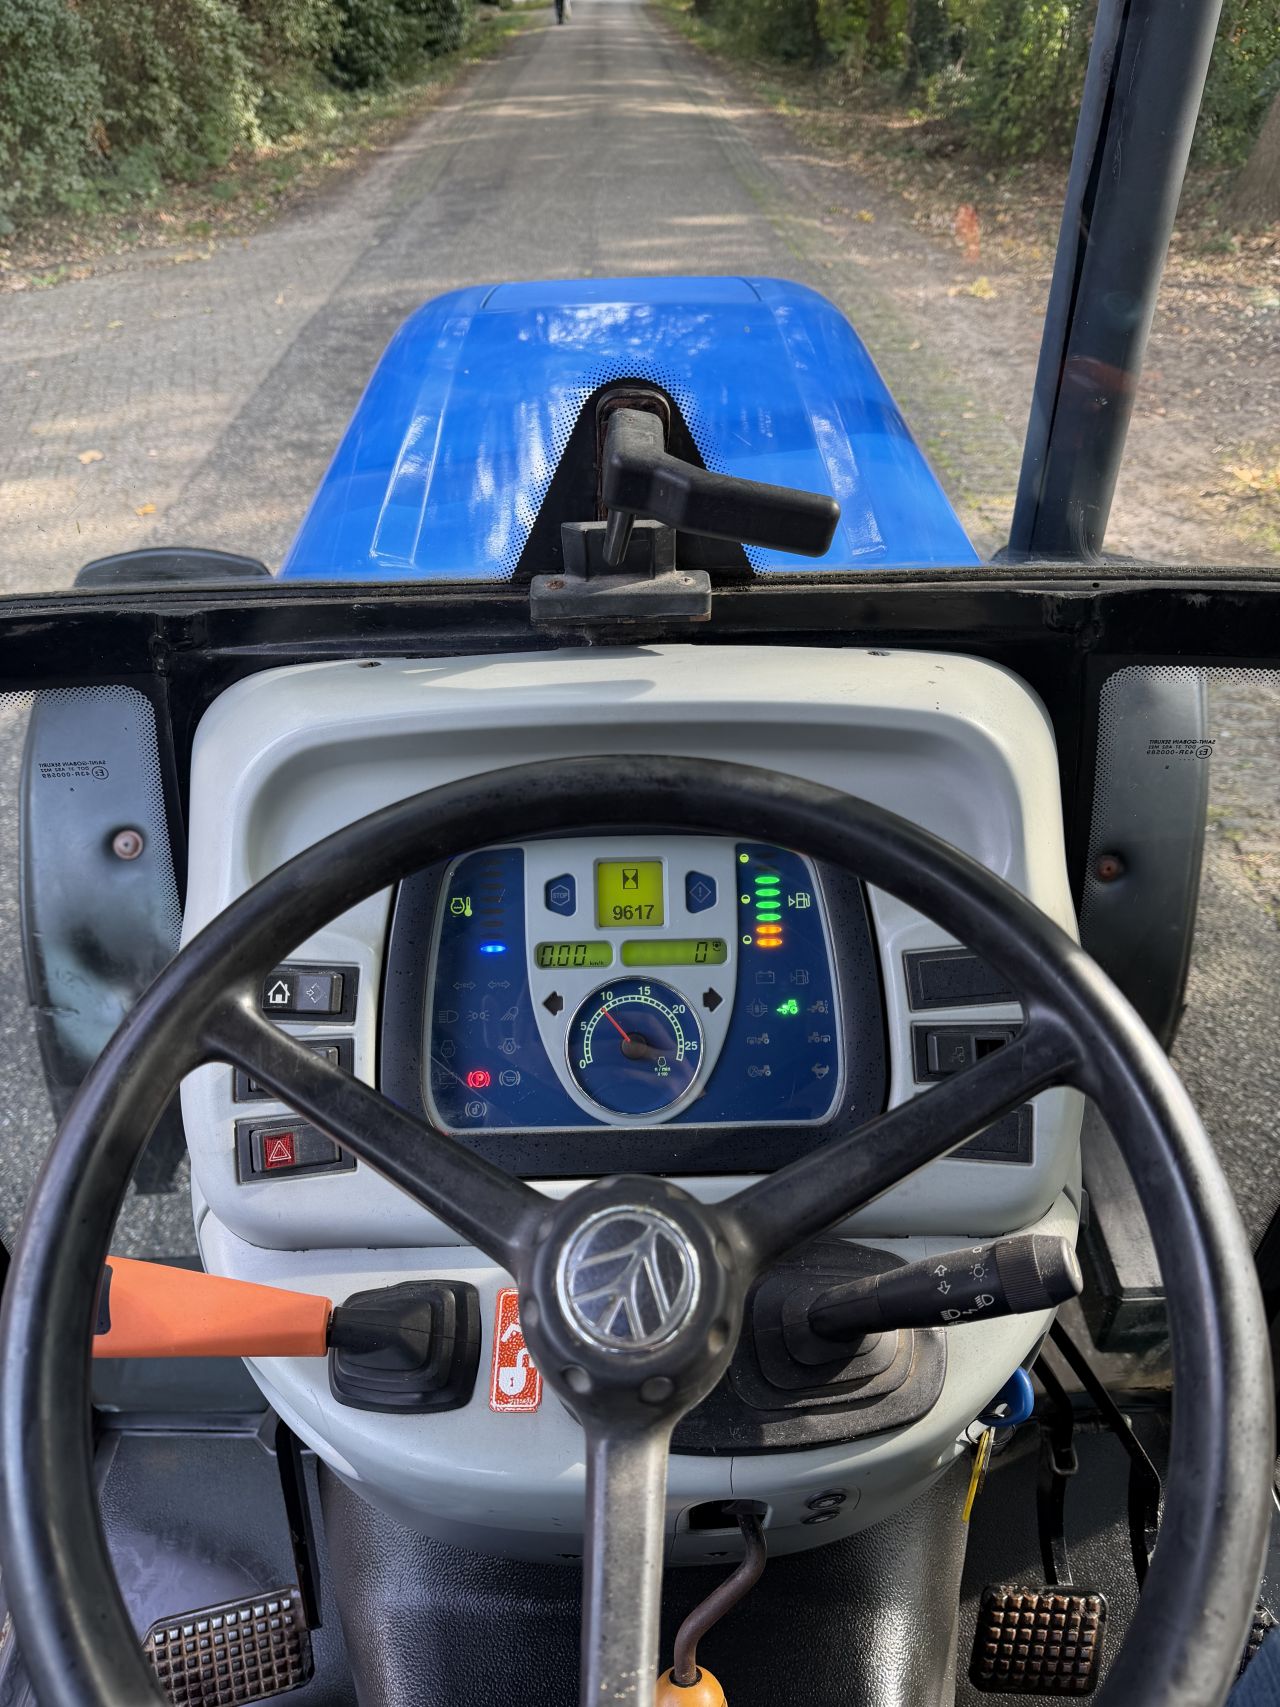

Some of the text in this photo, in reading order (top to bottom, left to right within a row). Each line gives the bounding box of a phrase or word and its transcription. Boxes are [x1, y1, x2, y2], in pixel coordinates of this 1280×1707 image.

[612, 904, 654, 920] 9617
[541, 944, 586, 967] 0.00
[695, 941, 707, 963] 0
[600, 991, 613, 1001] 10
[638, 986, 651, 996] 15
[672, 1004, 686, 1014] 20
[580, 1021, 587, 1031] 5
[684, 1041, 698, 1051] 25
[579, 1059, 586, 1069] 0
